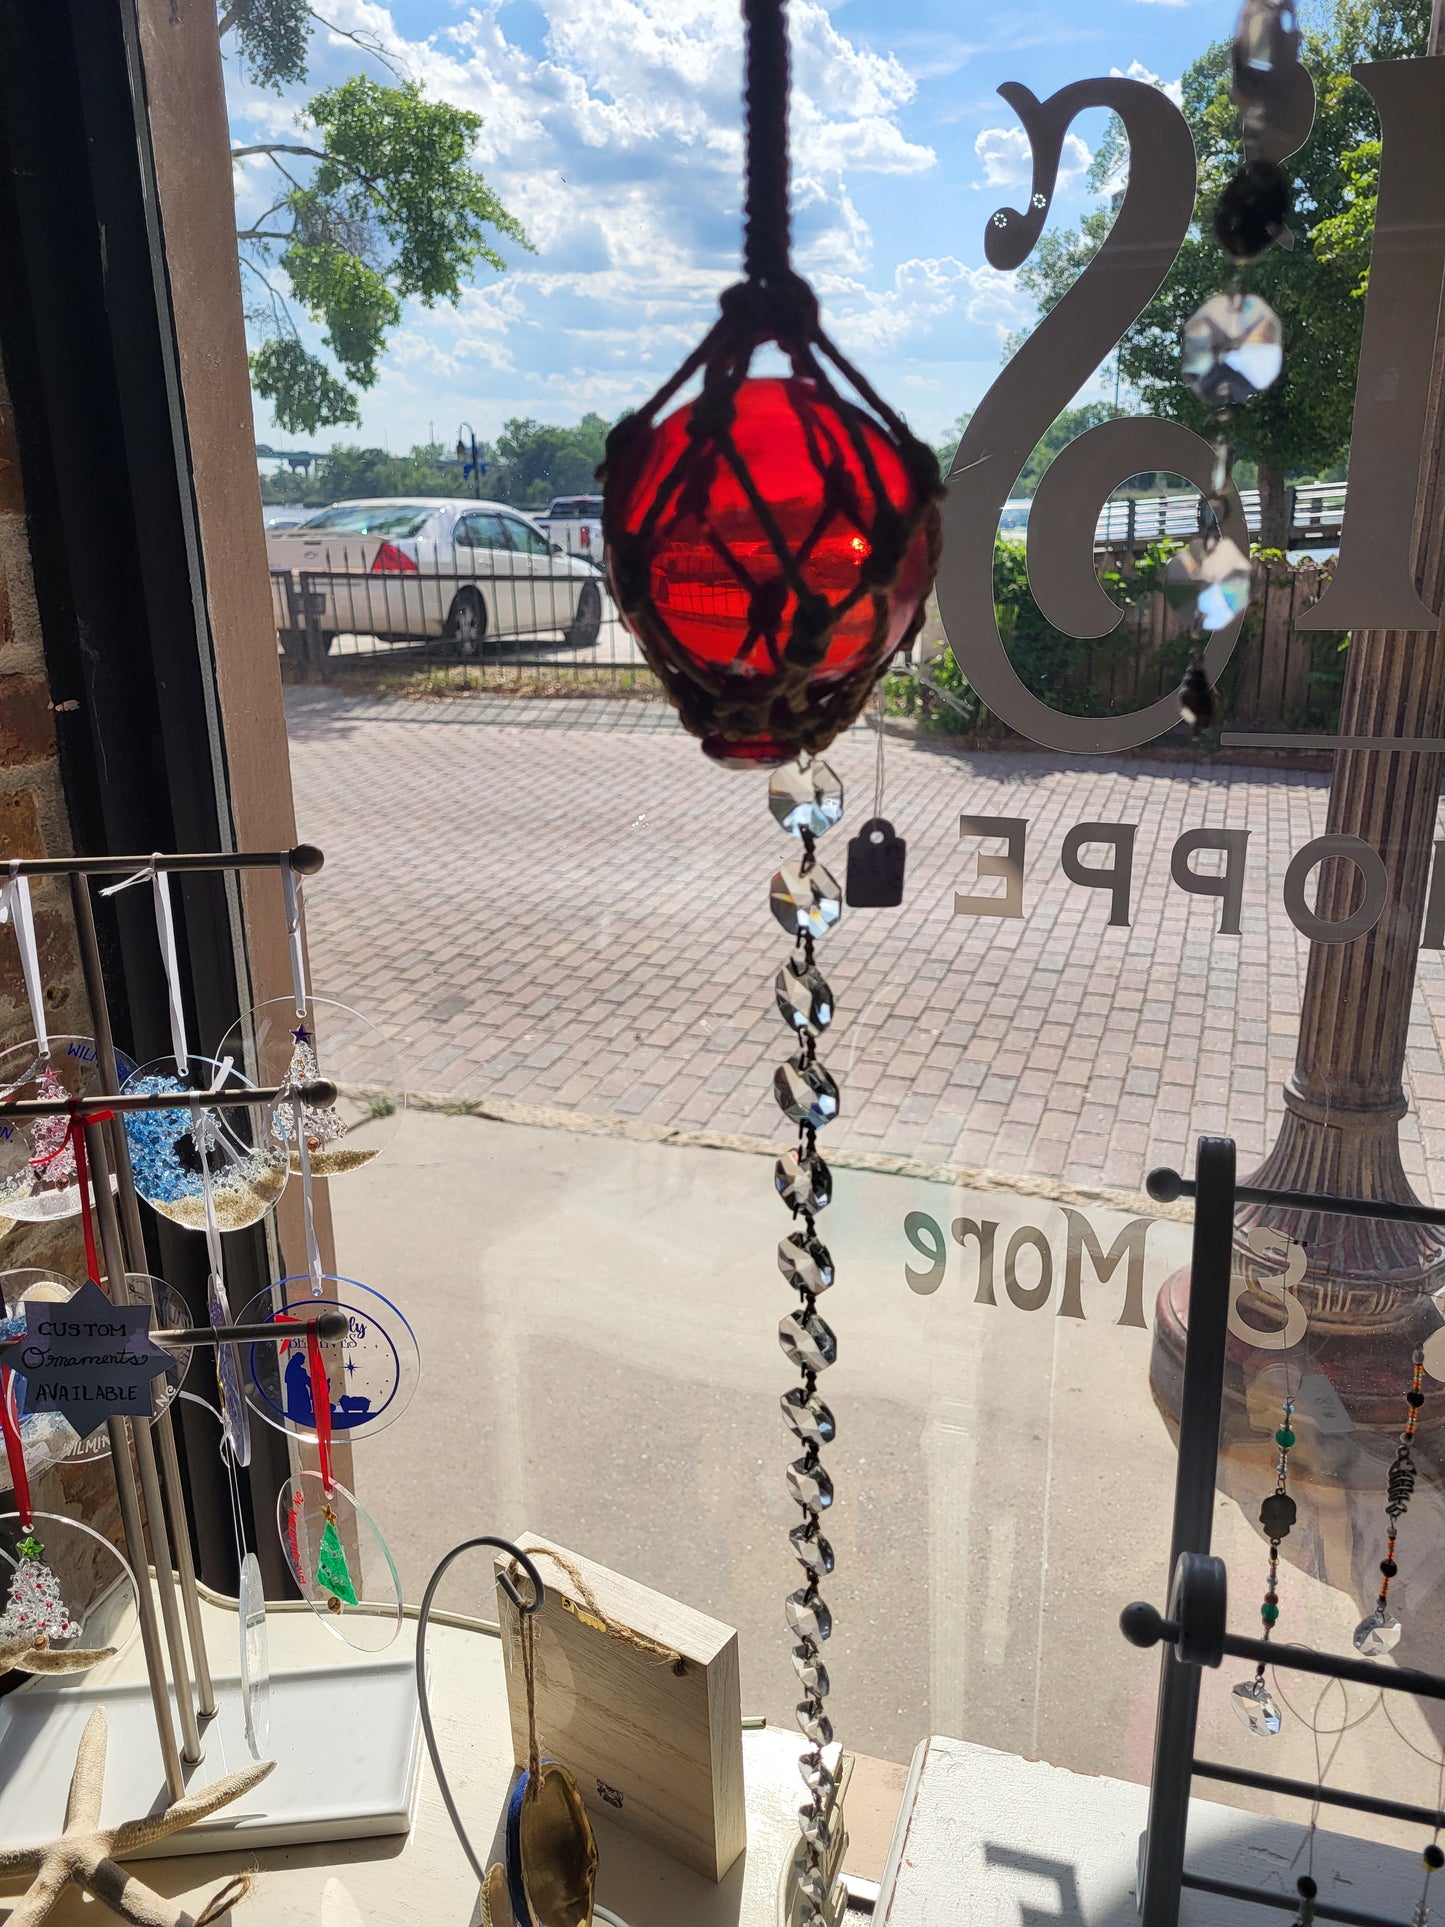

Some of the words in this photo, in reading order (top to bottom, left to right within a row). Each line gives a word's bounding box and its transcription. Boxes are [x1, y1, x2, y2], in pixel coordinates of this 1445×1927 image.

[38, 1321, 127, 1337] CUSTOM
[21, 1346, 149, 1370] Ornaments
[35, 1382, 138, 1402] AVAILABLE
